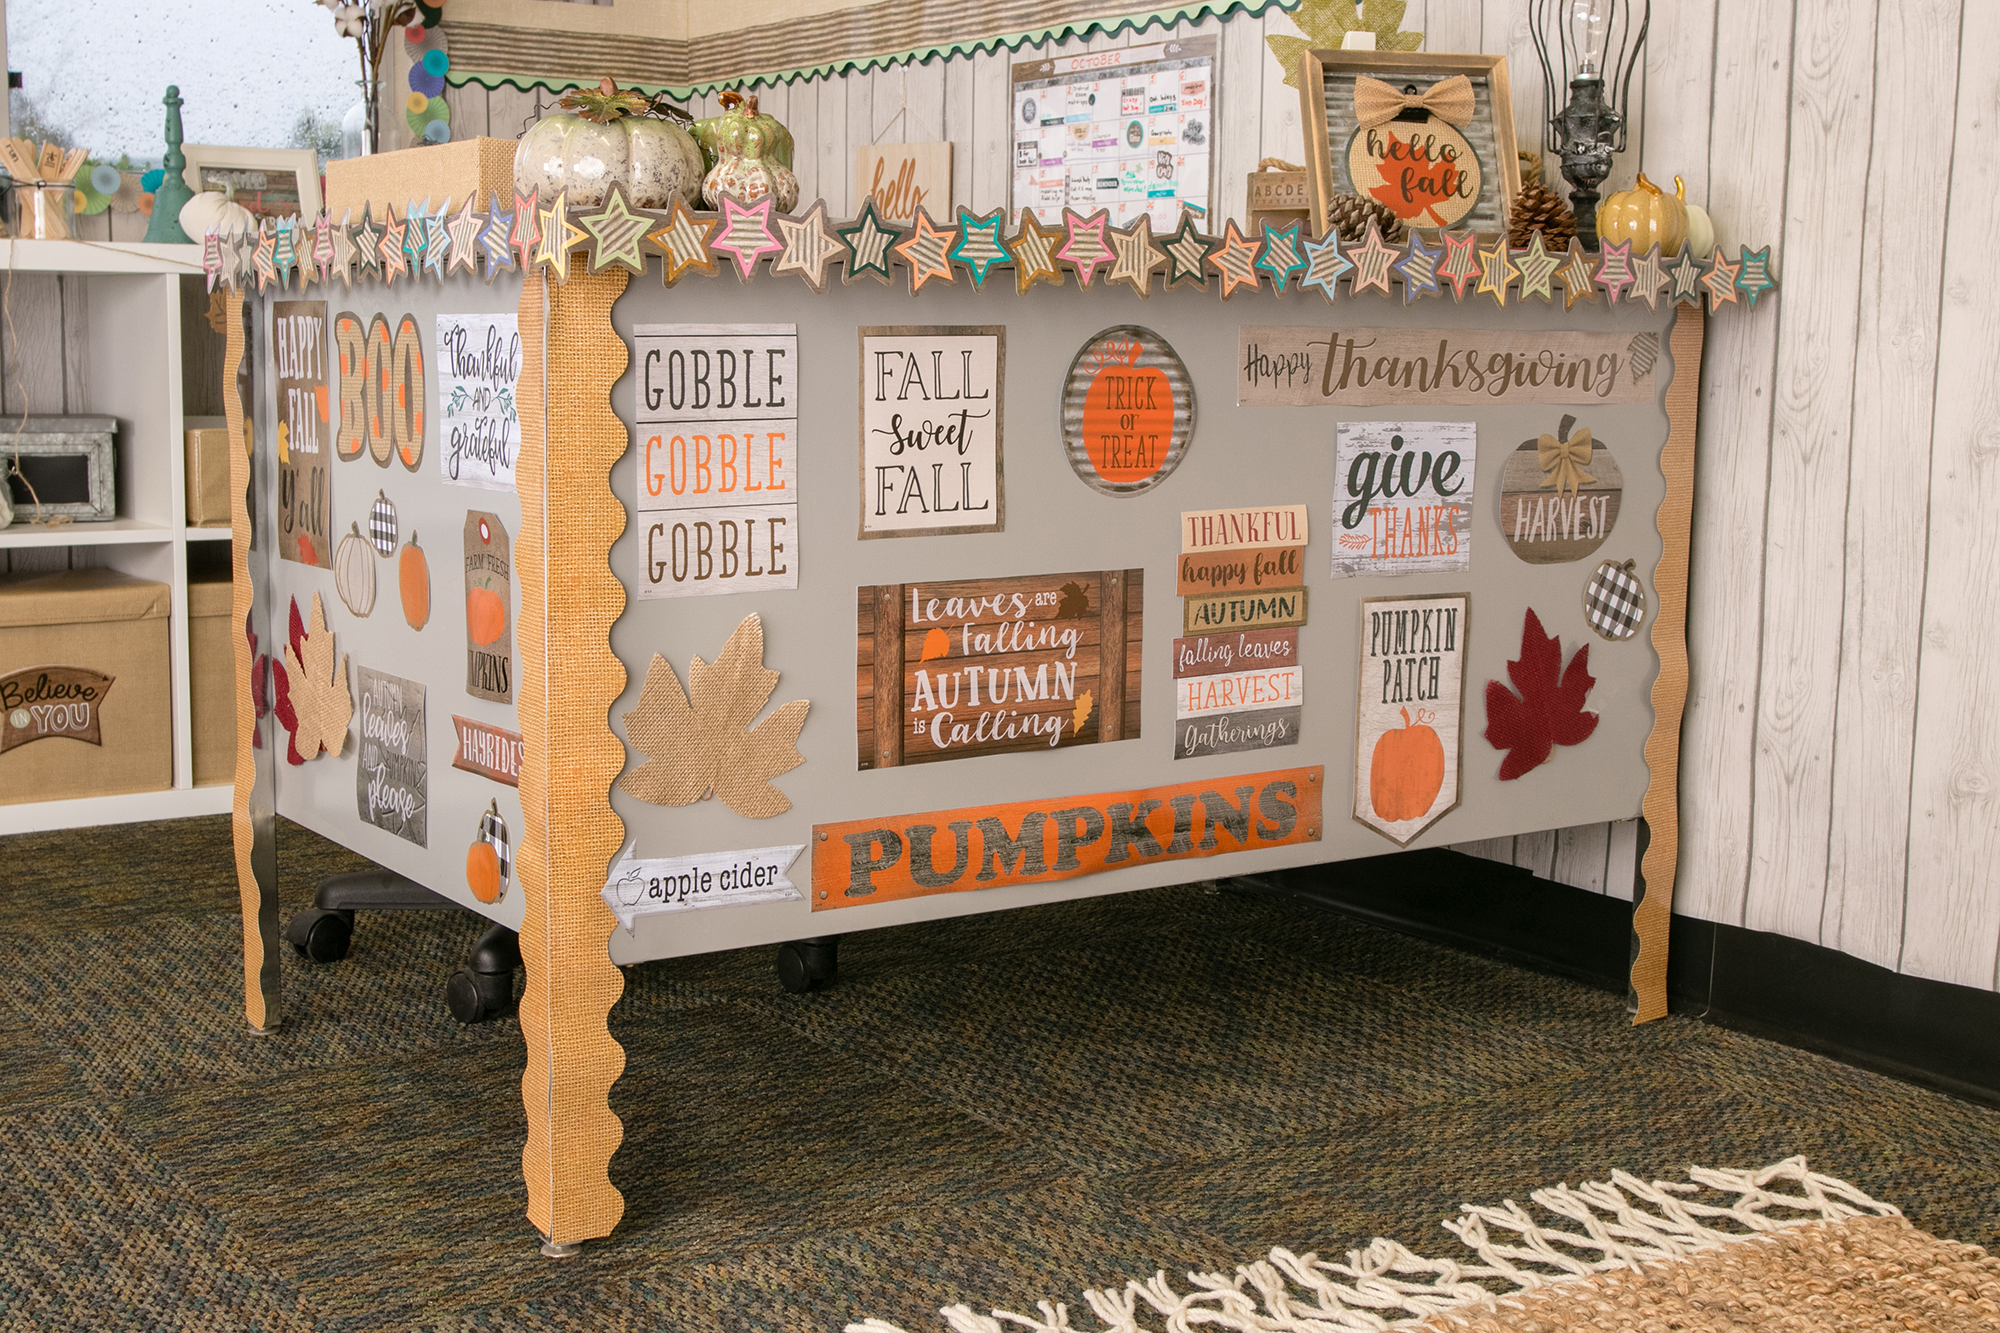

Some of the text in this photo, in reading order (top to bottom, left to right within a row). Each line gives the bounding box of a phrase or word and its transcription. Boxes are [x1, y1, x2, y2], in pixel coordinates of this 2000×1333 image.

[1071, 53, 1120, 70] OCTOBER
[5, 144, 19, 162] run
[1366, 128, 1463, 163] hello
[1400, 167, 1474, 204] fall
[277, 314, 322, 381] HAPPY
[1244, 343, 1313, 389] Happy
[334, 310, 426, 474] BOO
[644, 348, 786, 411] GOBBLE
[874, 350, 989, 402] FALL
[1105, 376, 1157, 410] TRICK
[472, 387, 492, 412] AND
[288, 387, 319, 454] FALL
[1120, 413, 1140, 431] or
[449, 415, 511, 480] grateful
[645, 432, 786, 497] GOBBLE
[1101, 435, 1158, 469] TREAT
[874, 462, 989, 516] FALL
[1341, 434, 1465, 530] give
[1187, 511, 1302, 547] THANKFUL
[1369, 505, 1460, 559] THANKS
[1513, 495, 1610, 543] HARVEST
[465, 553, 509, 581] FARM FRESH
[648, 517, 787, 583] GOBBLE
[1182, 549, 1299, 588] happy fall
[912, 587, 1057, 623] Leaves are
[1194, 595, 1296, 626] AUTUMN
[962, 620, 1084, 660] Falling
[1370, 607, 1458, 657] PUMPKIN
[1179, 633, 1292, 673] falling leaves
[0, 673, 98, 710] Believe
[373, 678, 403, 713] AUTUMN
[910, 661, 1077, 712] AUTUMN
[1188, 672, 1295, 712] HARVEST
[1381, 656, 1441, 704] PATCH
[13, 702, 89, 733] IN YOU
[363, 692, 409, 755] leaves
[913, 710, 1069, 749] is Calling
[362, 742, 378, 771] AND
[463, 726, 524, 776] HAYRIDES
[368, 762, 415, 822] please
[842, 780, 1298, 898] PUMPKINS
[649, 862, 778, 903] apple cider
